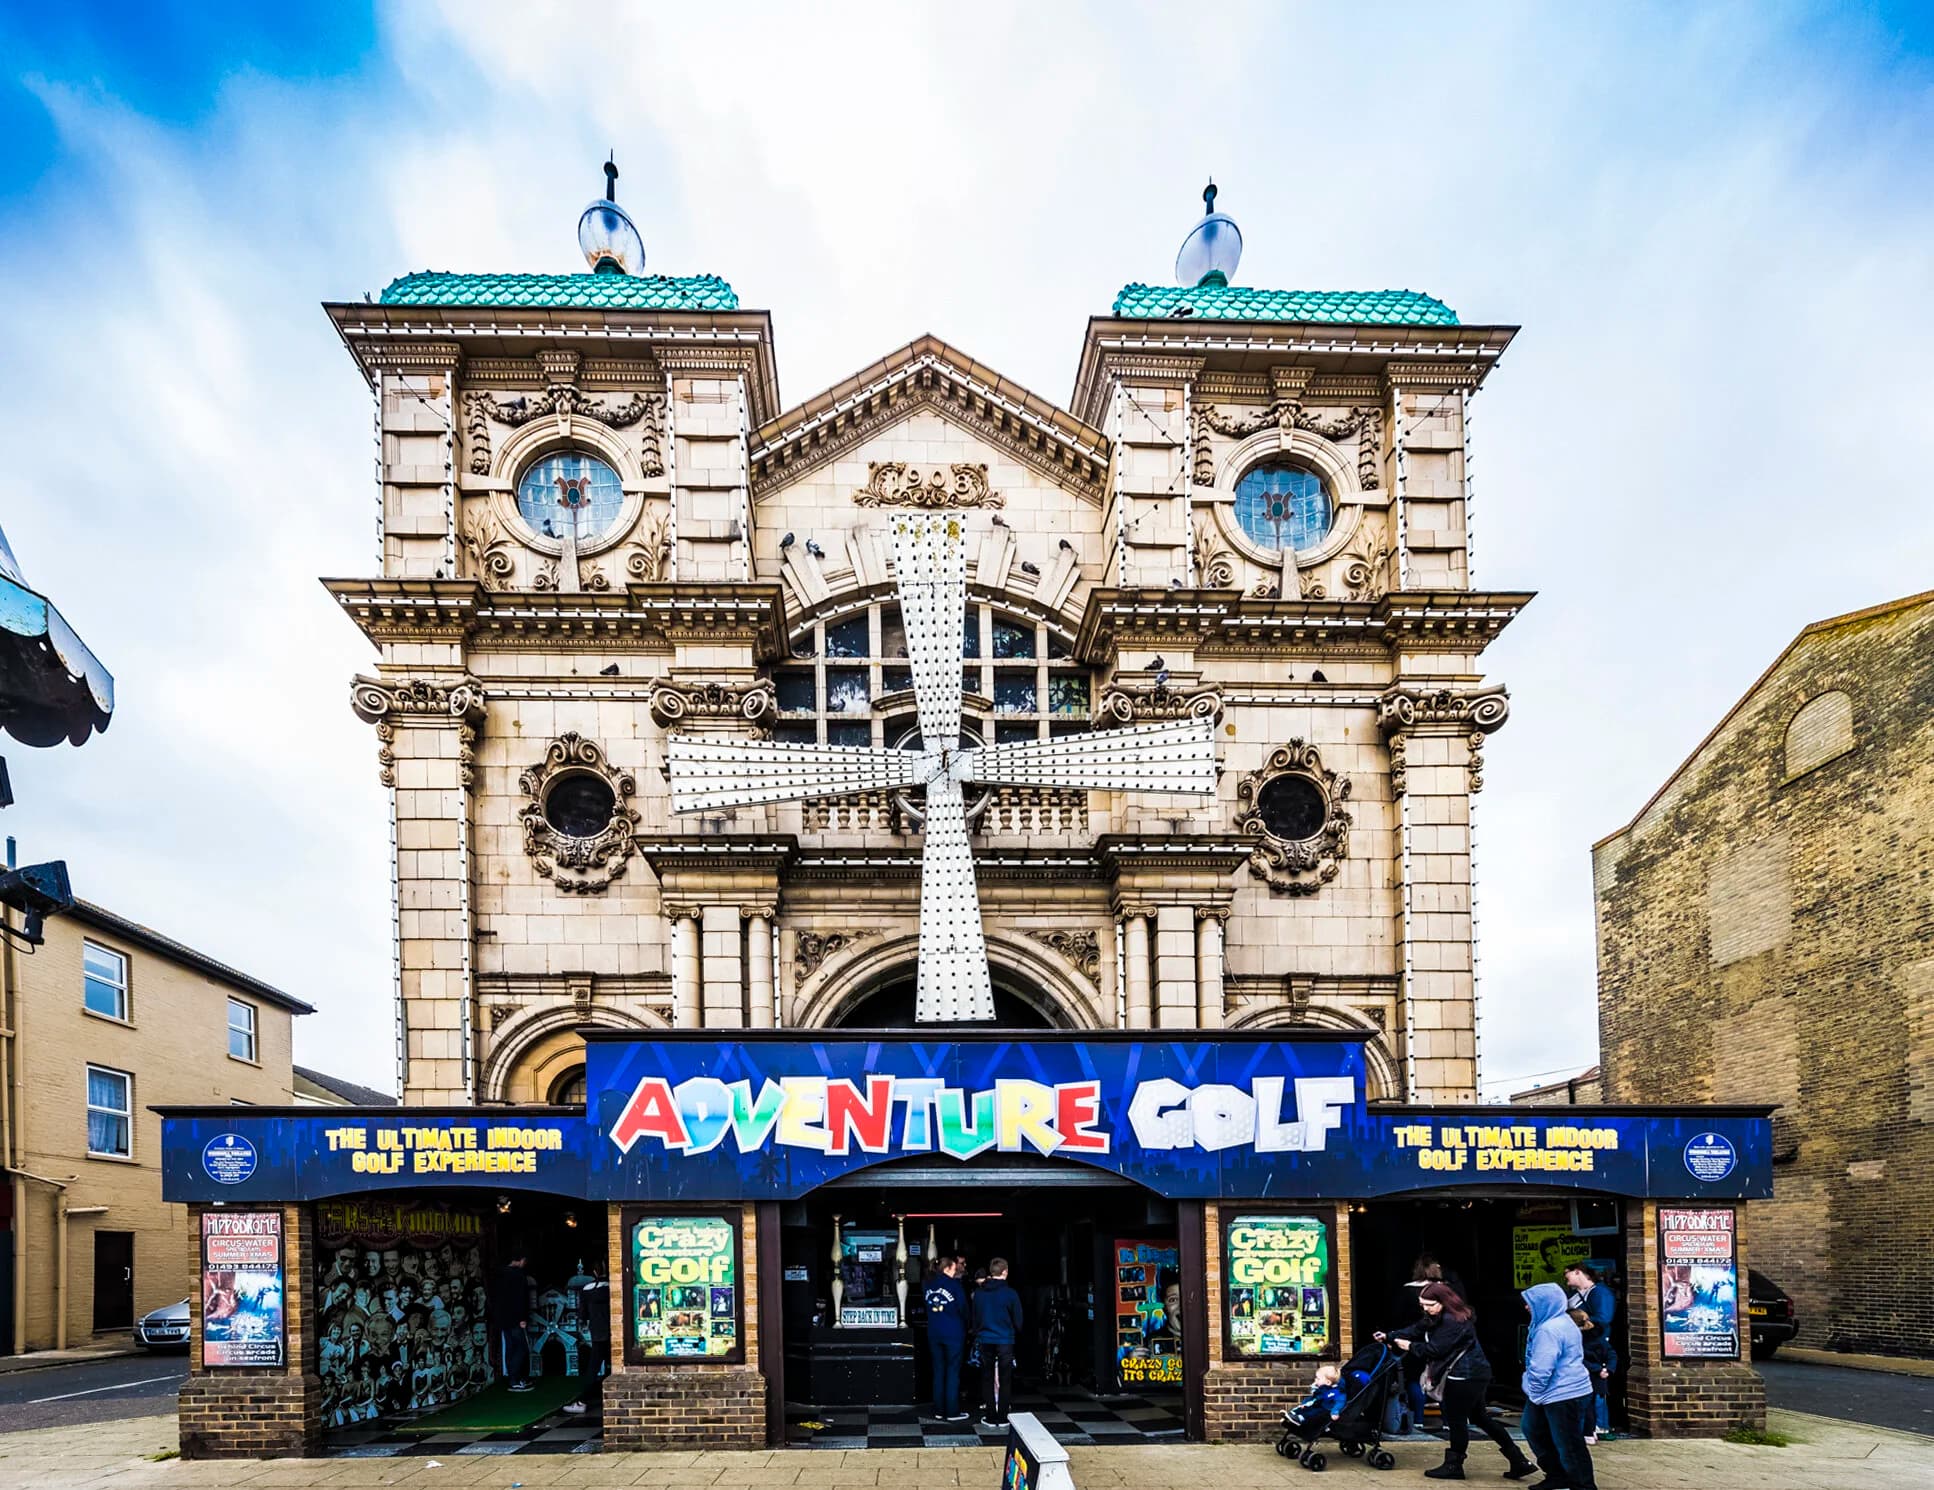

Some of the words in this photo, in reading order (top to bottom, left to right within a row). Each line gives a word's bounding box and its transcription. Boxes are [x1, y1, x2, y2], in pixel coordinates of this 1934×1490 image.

[890, 470, 970, 495] 1908
[608, 1075, 1111, 1161] ADVENTURE
[1128, 1075, 1356, 1153] GOLF
[325, 1127, 367, 1151] THE
[377, 1127, 477, 1151] ULTIMATE
[487, 1127, 563, 1150] INDOOR
[1393, 1125, 1432, 1148] THE
[1441, 1126, 1537, 1149] ULTIMATE
[1546, 1127, 1618, 1150] INDOOR
[351, 1151, 404, 1173] GOLF
[413, 1150, 537, 1173] EXPERIENCE
[1418, 1149, 1467, 1171] GOLF
[1476, 1148, 1594, 1171] EXPERIENCE
[207, 1219, 277, 1234] HIPPODROME
[1664, 1215, 1731, 1230] HIPPODROME
[243, 1239, 273, 1247] WATER
[638, 1225, 730, 1252] Crazy
[1230, 1227, 1320, 1254] Crazy
[842, 1310, 857, 1324] STEP
[857, 1310, 872, 1324] BACK
[873, 1310, 881, 1324] IN
[881, 1310, 896, 1324] TIME
[1120, 1358, 1163, 1370] CRAZY
[1123, 1370, 1145, 1381] ITS
